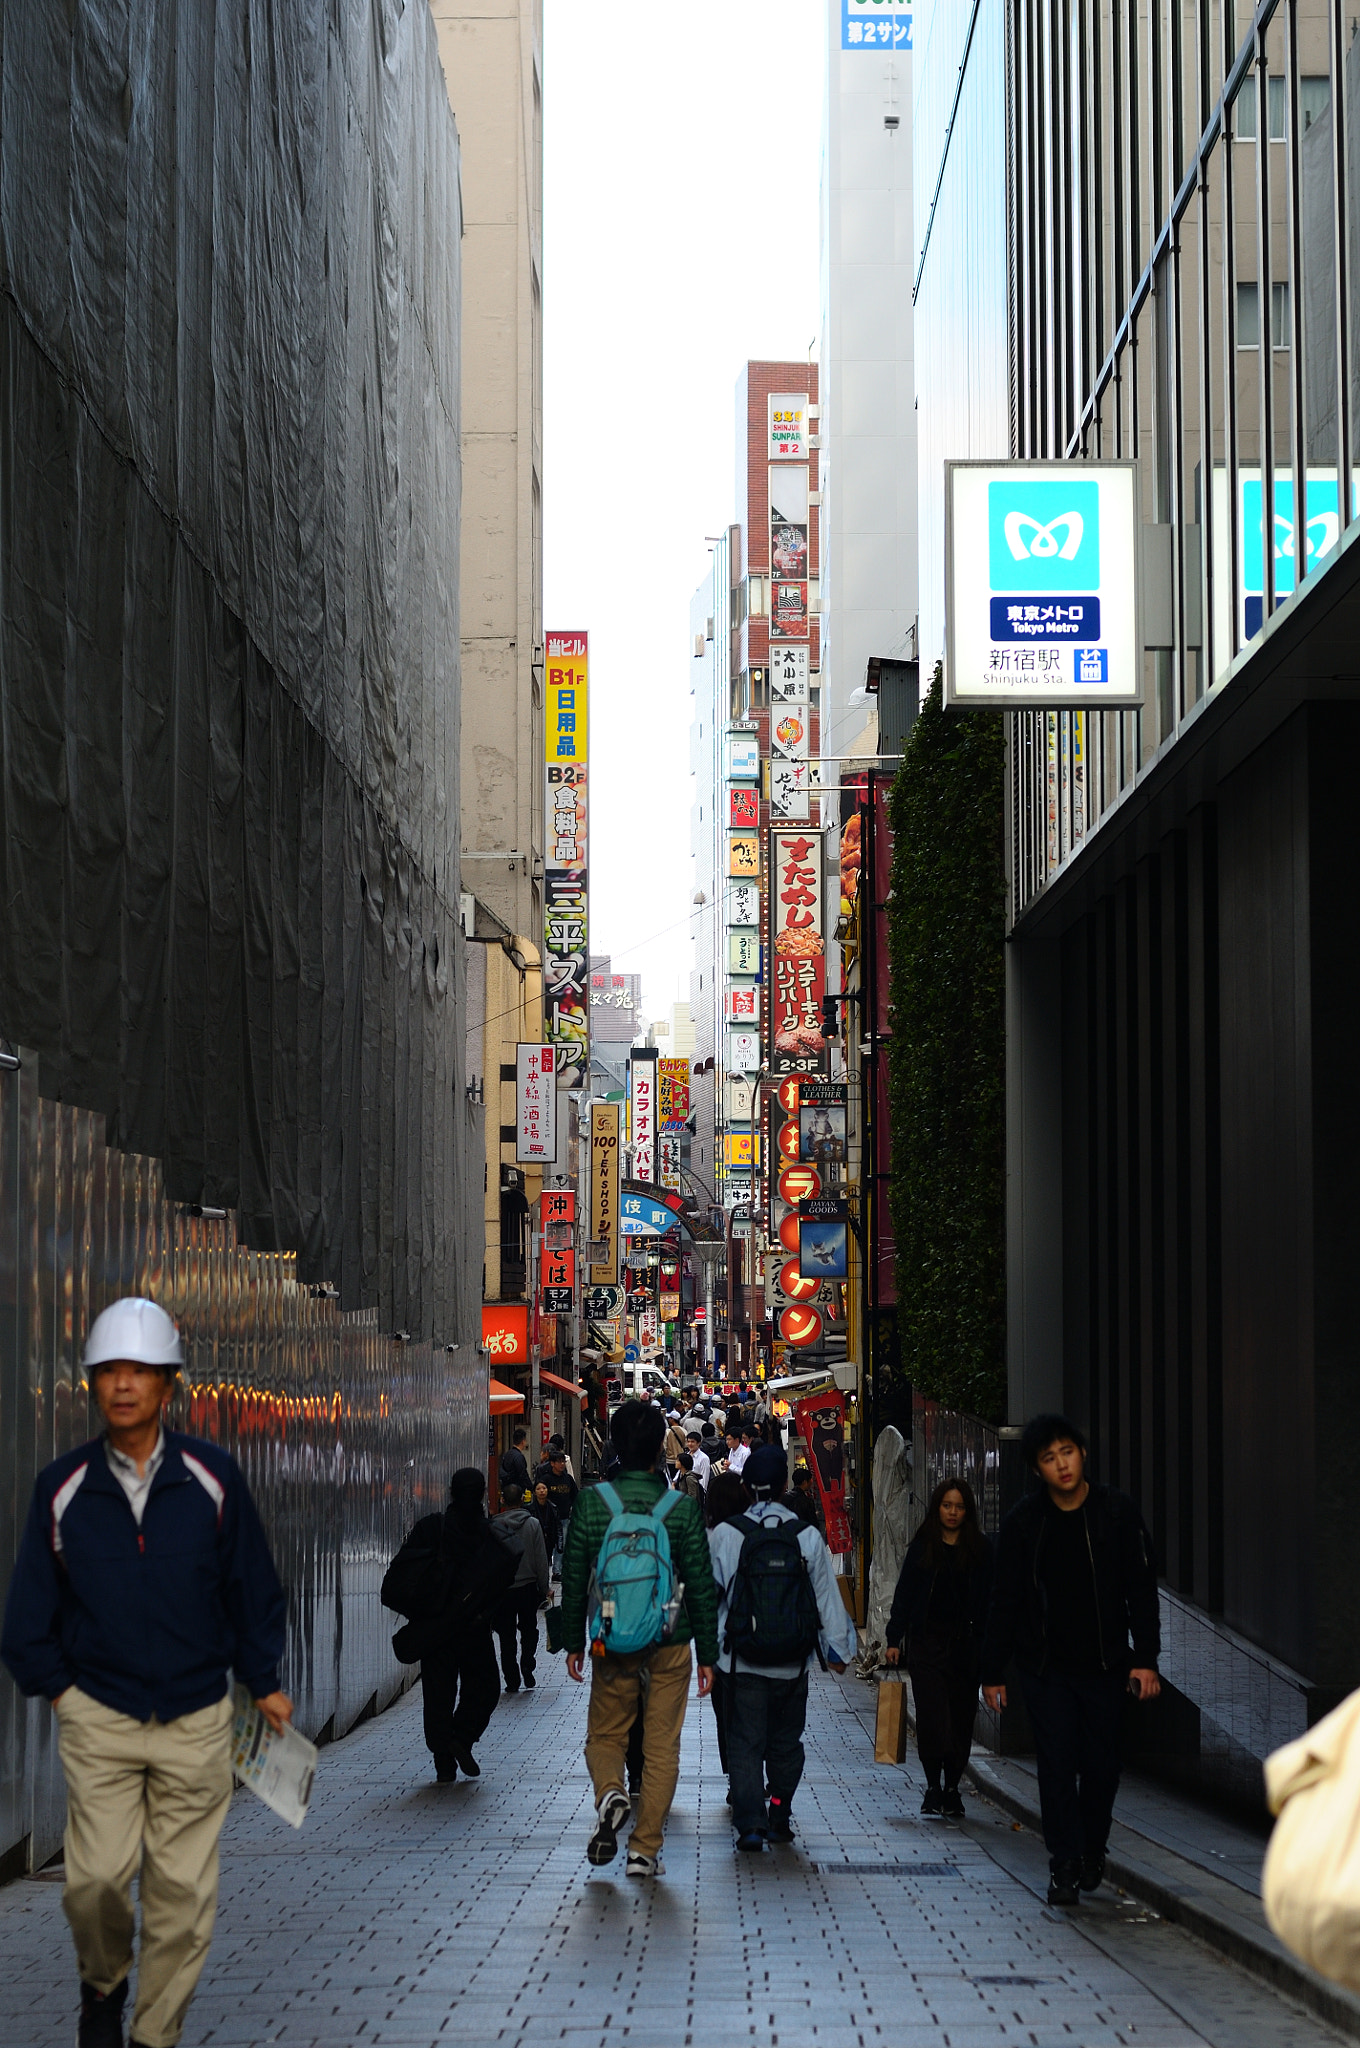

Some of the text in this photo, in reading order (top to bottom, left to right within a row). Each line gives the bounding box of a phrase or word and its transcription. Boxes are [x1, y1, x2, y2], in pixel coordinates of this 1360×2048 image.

[772, 433, 802, 441] SUNPAR
[779, 443, 799, 453] 第2
[1006, 604, 1084, 621] 東京メトロ
[1011, 621, 1079, 635] Tokyo Metro
[548, 638, 586, 657] 当ビル
[989, 649, 1061, 671] 新宿駅
[549, 668, 585, 686] B1F
[783, 650, 796, 696] 大小原
[983, 672, 1068, 685] Shinjuku Sta.
[556, 689, 576, 756] 日用品
[547, 766, 585, 784] B2F
[553, 785, 579, 861] 食料品
[547, 881, 585, 1072] 三平ストア
[592, 975, 624, 987] 焼肉
[776, 960, 799, 1031] ハンバーグ
[798, 958, 820, 1028] ステーキ&
[522, 1054, 541, 1140] 中央線酒場
[660, 1077, 673, 1117] お好み焼
[805, 1091, 841, 1099] LEATHER
[660, 1120, 683, 1131] 1380
[593, 1136, 617, 1148] 100
[599, 1150, 609, 1177] YEN
[600, 1180, 610, 1218] SHOP
[808, 1206, 838, 1214] GOODS
[621, 1223, 644, 1234] 通り
[549, 1289, 569, 1298] モア
[587, 1300, 605, 1308] モア
[482, 1329, 518, 1354] ばる
